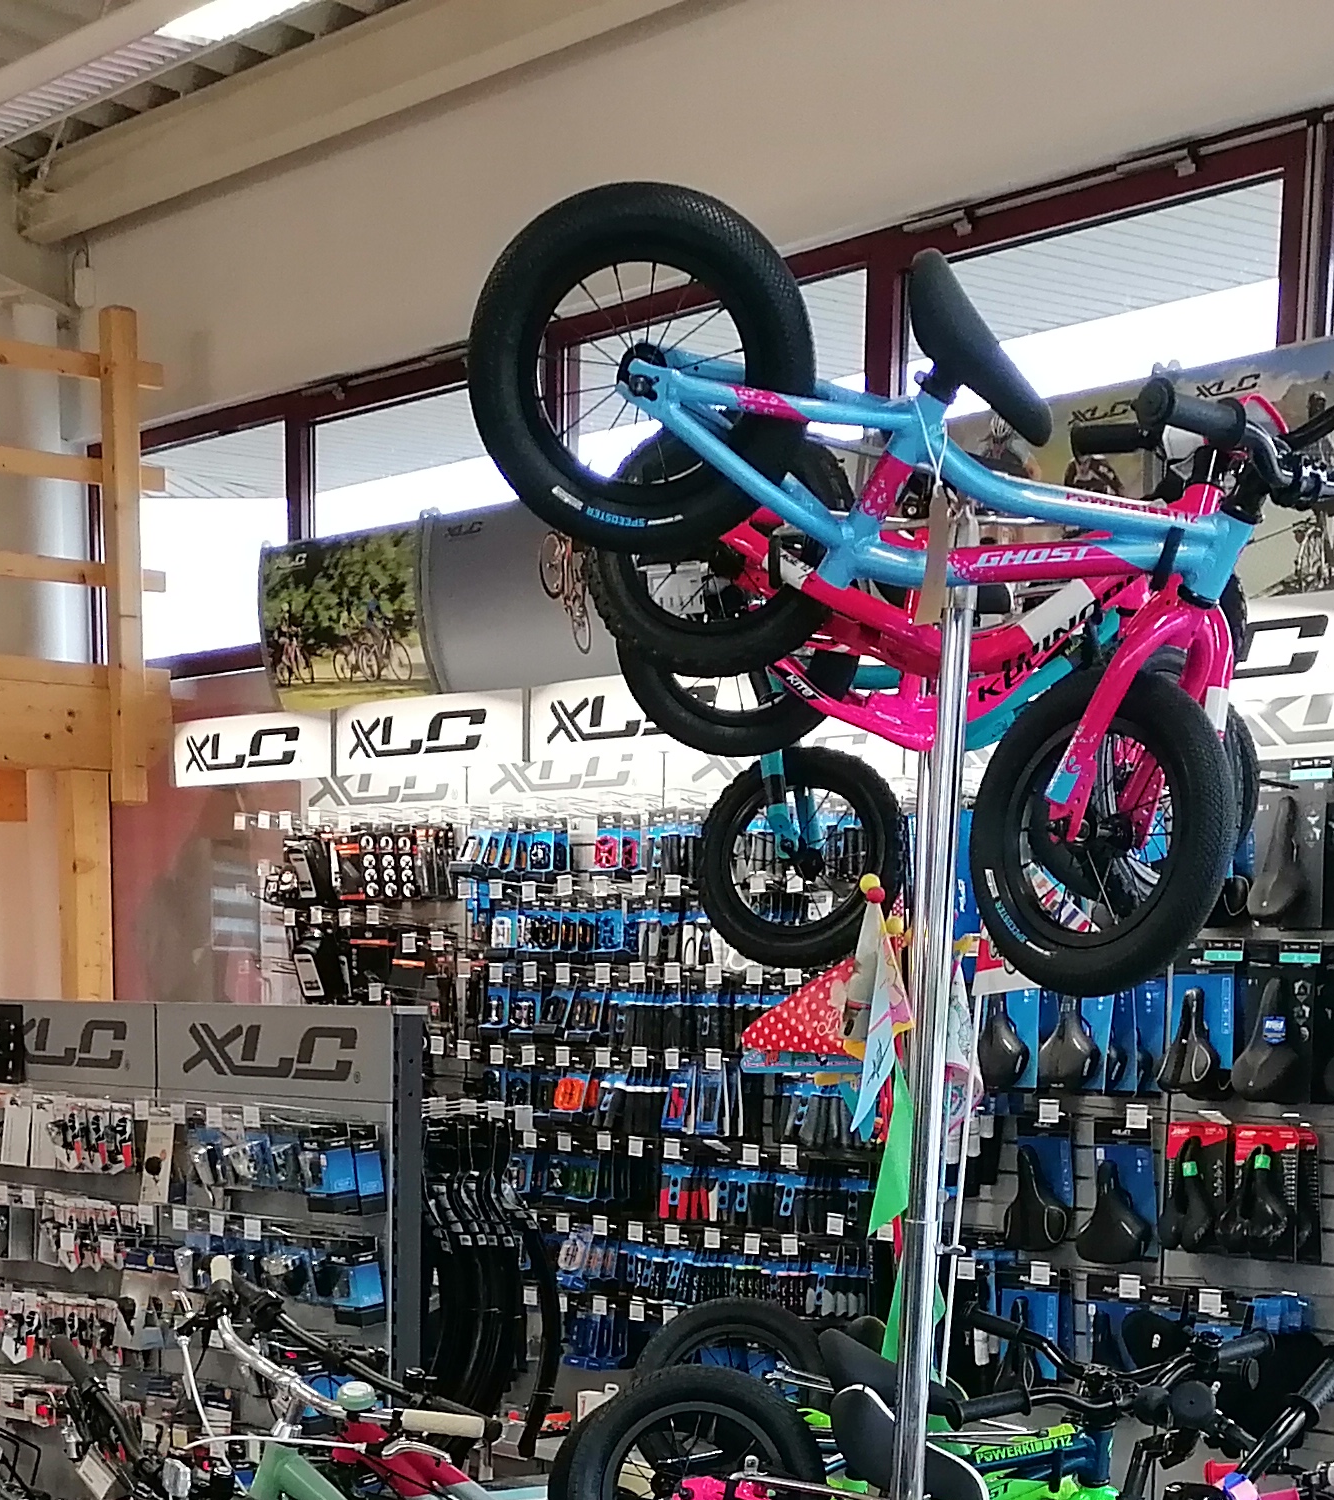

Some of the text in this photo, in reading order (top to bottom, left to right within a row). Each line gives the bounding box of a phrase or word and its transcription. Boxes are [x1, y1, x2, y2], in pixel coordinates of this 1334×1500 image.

[976, 546, 1094, 568] GHOST
[348, 708, 488, 760] XLC
[547, 695, 667, 745] XL
[185, 726, 301, 774] XLC
[182, 1022, 358, 1081] XLC
